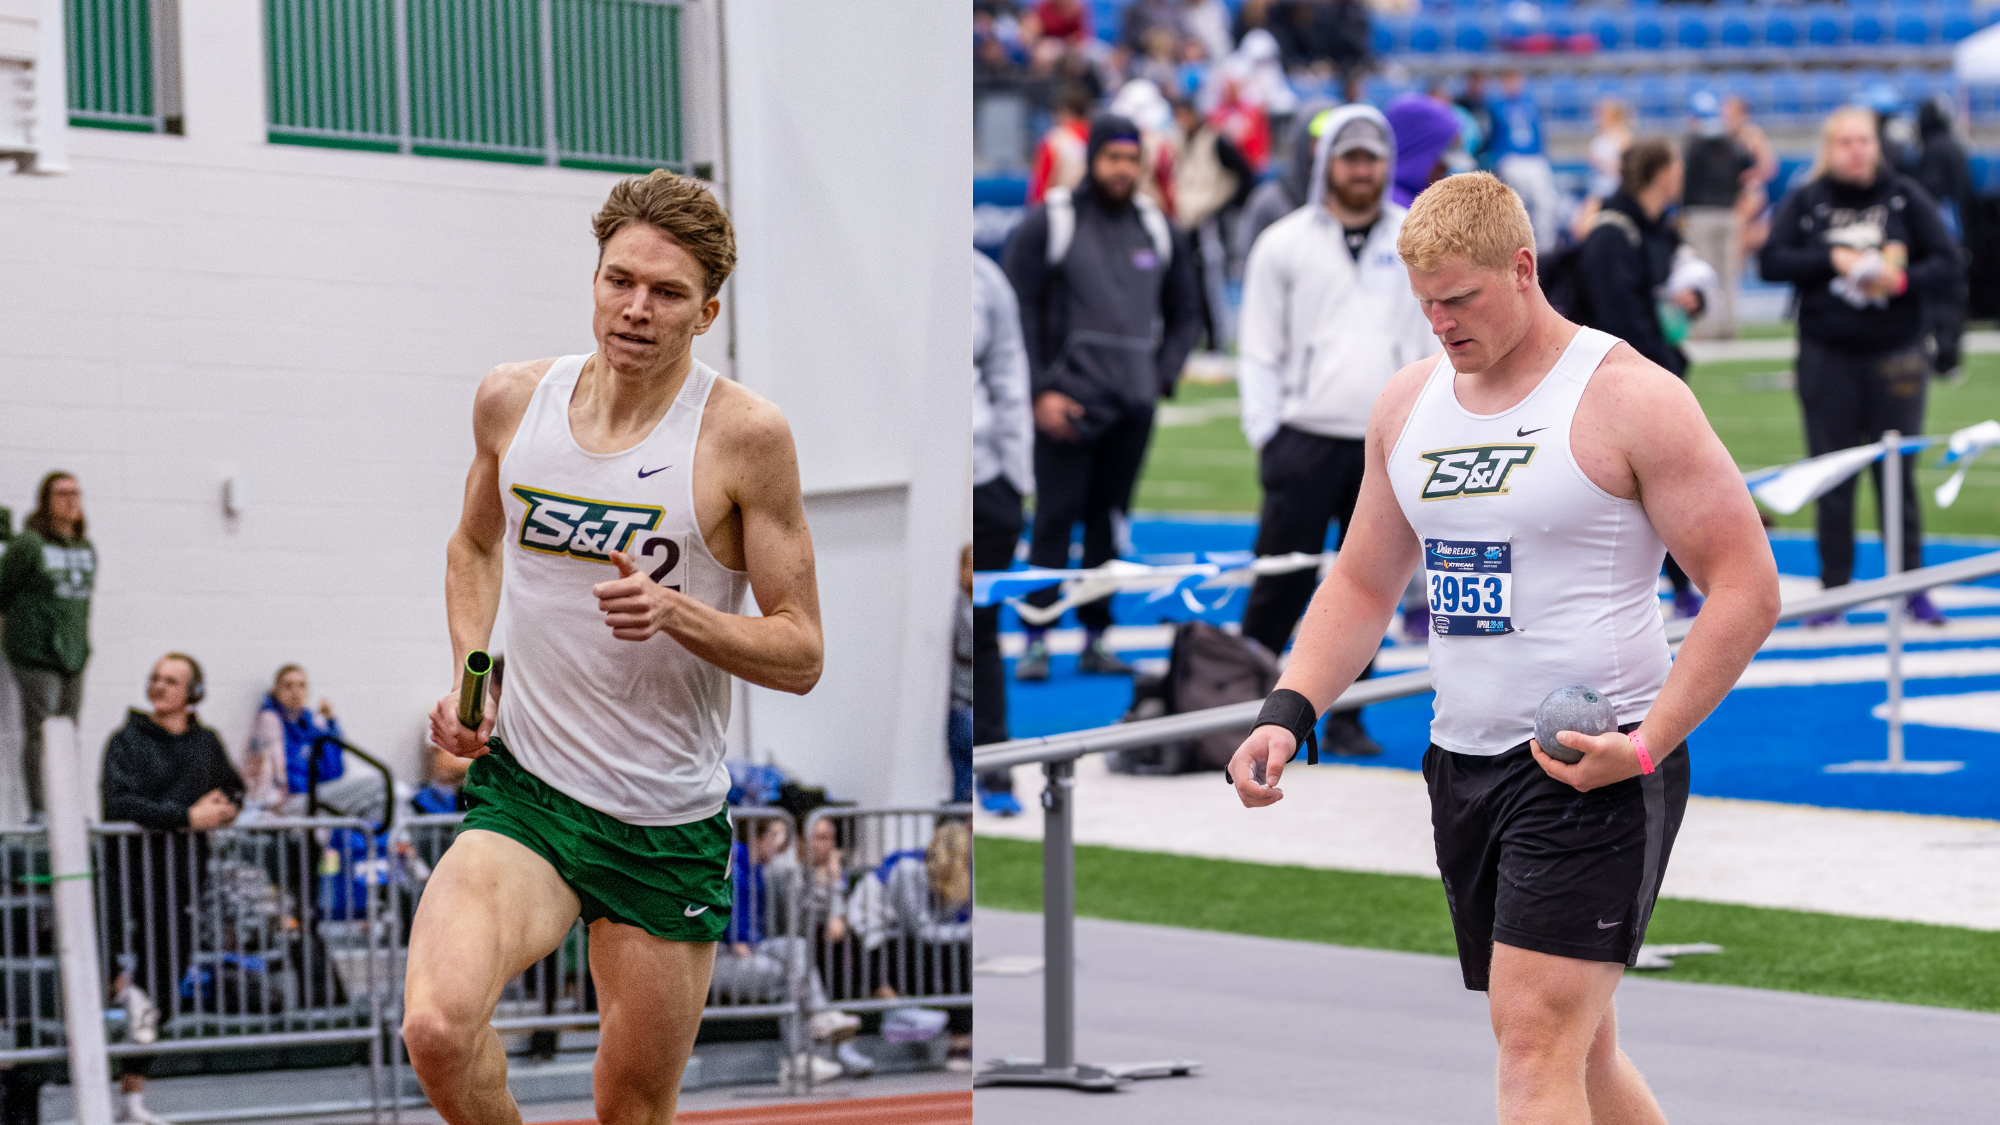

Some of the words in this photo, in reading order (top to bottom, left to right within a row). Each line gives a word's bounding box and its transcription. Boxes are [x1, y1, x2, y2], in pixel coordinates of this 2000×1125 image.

[1426, 449, 1528, 493] S&T
[524, 496, 652, 555] S&T
[641, 537, 681, 592] 2
[1452, 547, 1476, 555] RELAYS
[1430, 574, 1502, 614] 3953
